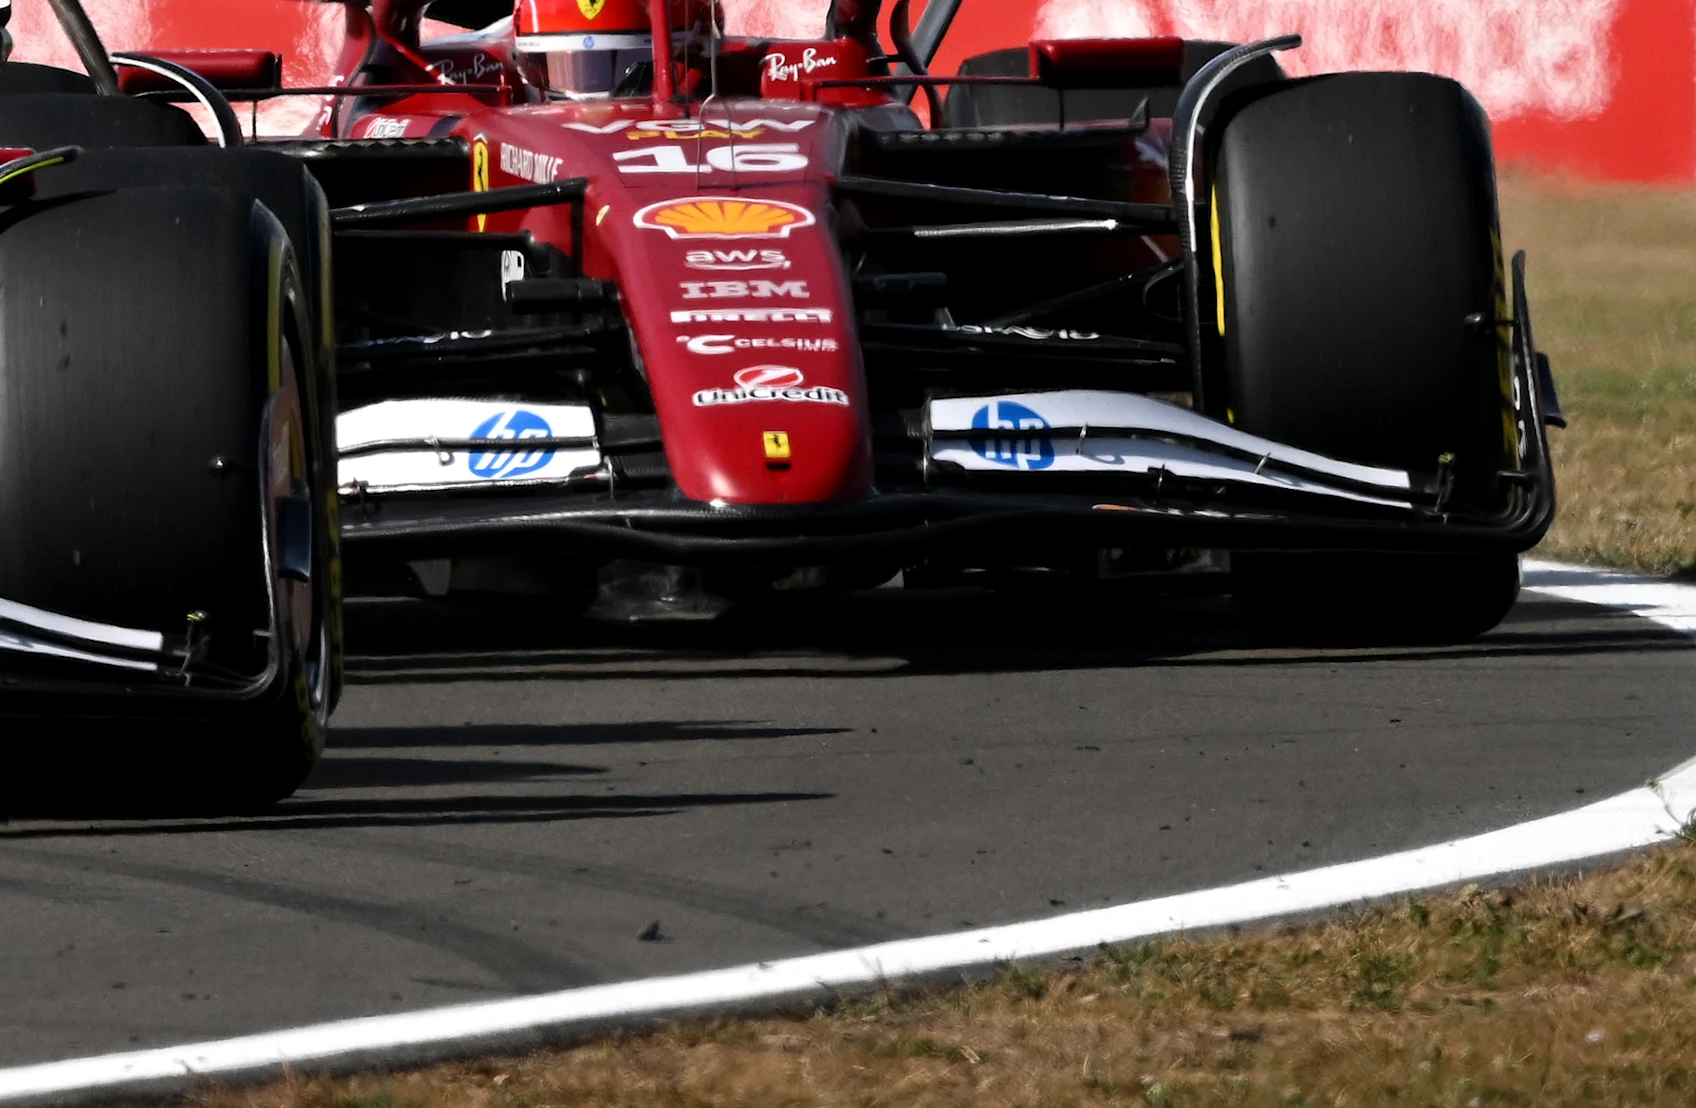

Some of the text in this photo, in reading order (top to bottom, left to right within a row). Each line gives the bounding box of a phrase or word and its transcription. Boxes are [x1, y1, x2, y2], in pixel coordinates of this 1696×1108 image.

[765, 48, 837, 81] Ray-Ban
[561, 119, 817, 134] VGW
[626, 128, 767, 140] PLAY
[612, 143, 809, 173] 16
[686, 249, 787, 264] aws
[680, 280, 810, 299] IBM
[697, 388, 847, 404] UniCredit
[472, 410, 550, 478] hp
[984, 401, 1046, 470] hp
